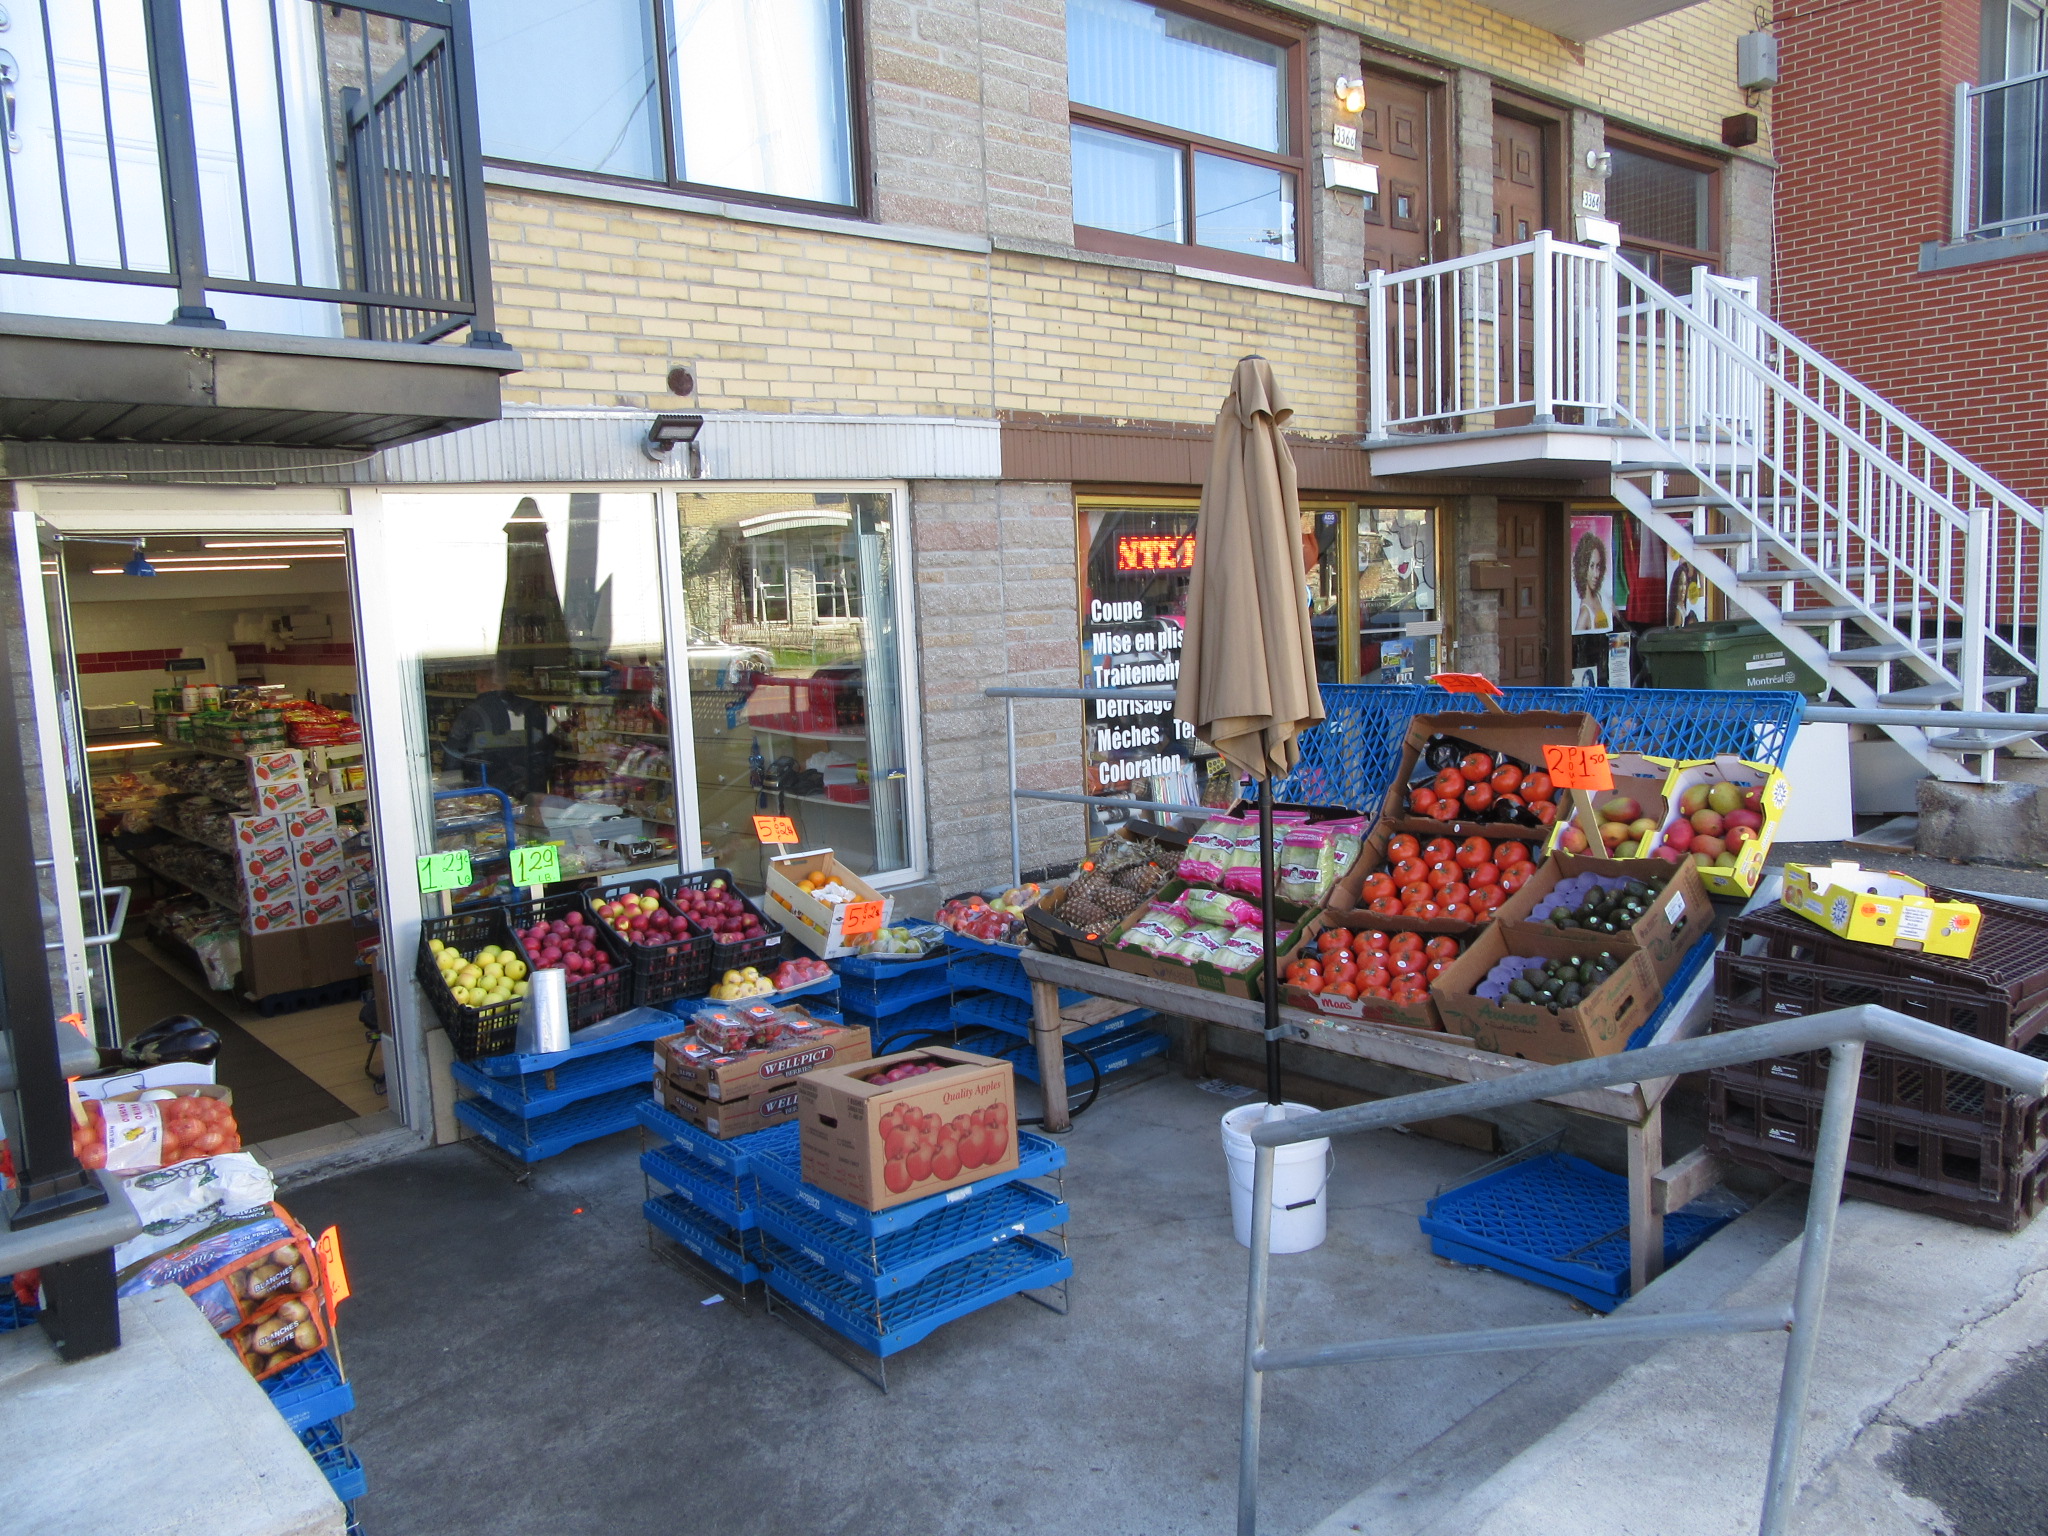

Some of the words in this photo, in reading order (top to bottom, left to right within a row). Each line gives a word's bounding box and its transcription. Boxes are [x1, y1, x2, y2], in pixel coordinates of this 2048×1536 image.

[1335, 127, 1355, 147] 3366
[1091, 599, 1143, 622] Coupe
[1092, 631, 1132, 655] Mise
[1134, 632, 1155, 652] en
[1157, 626, 1184, 653] plis
[1747, 674, 1785, 687] Montréal
[1097, 725, 1161, 752] Méches
[1099, 754, 1181, 785] Coloration
[1548, 748, 1564, 774] 2
[758, 820, 773, 837] 5
[1299, 870, 1319, 880] BOY
[848, 907, 863, 928] 5
[1321, 998, 1353, 1010] Maas
[784, 1065, 814, 1078] BERRIES
[942, 1087, 974, 1105] Quality
[975, 1080, 1001, 1095] Apples
[254, 1264, 294, 1292] BLANCHES
[259, 1320, 300, 1346] BLANCHES
[270, 1332, 295, 1348] WHITE
